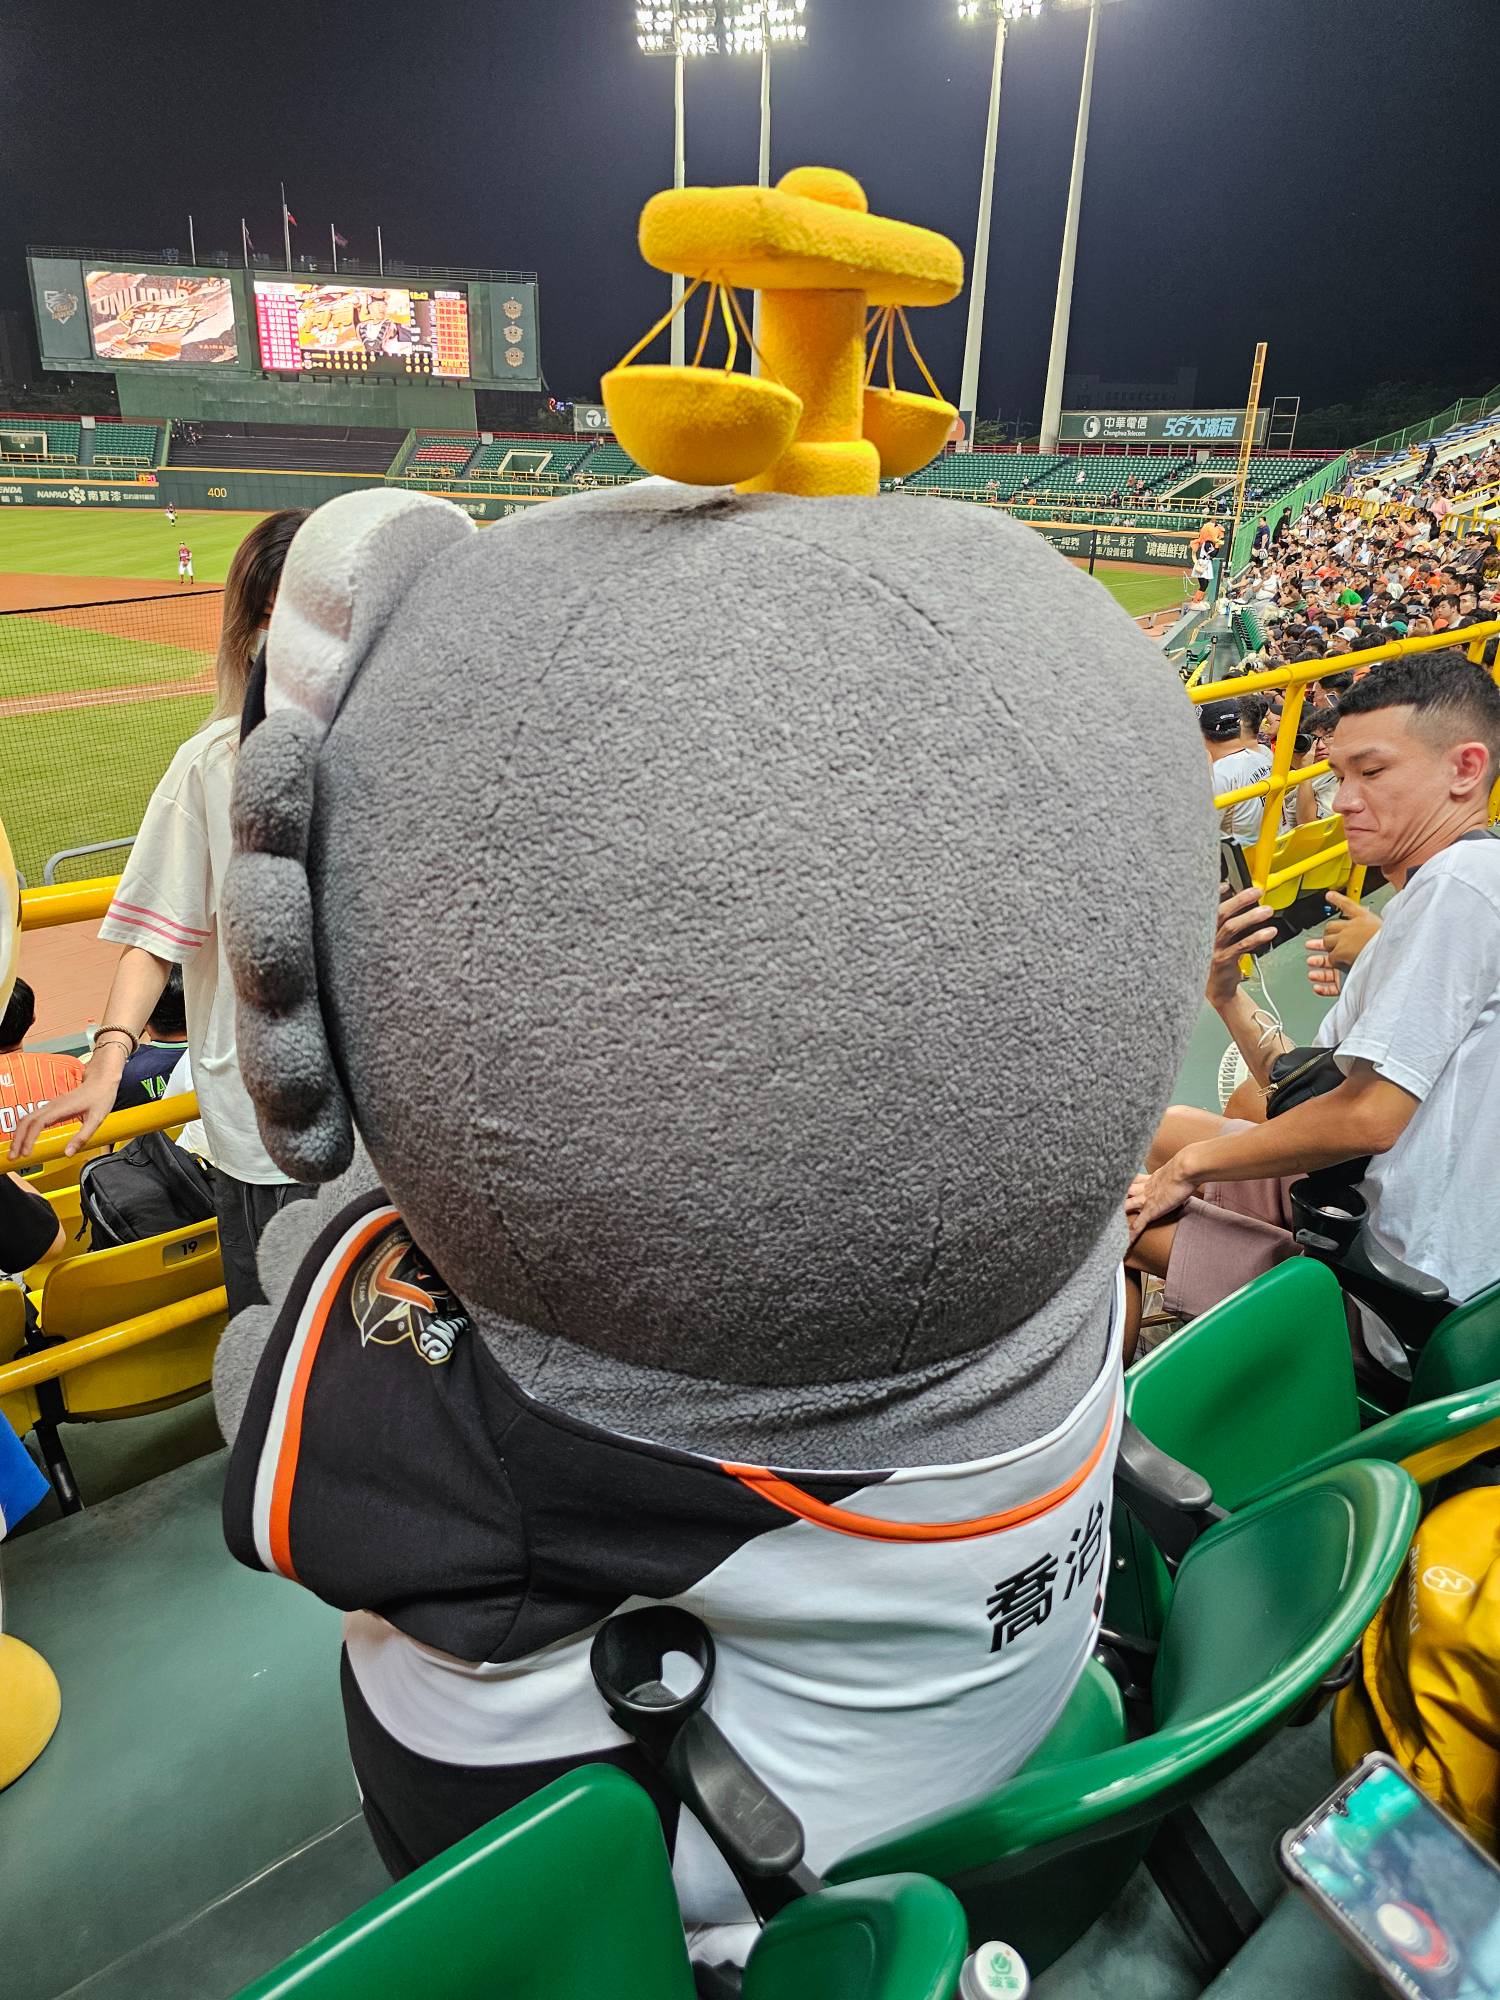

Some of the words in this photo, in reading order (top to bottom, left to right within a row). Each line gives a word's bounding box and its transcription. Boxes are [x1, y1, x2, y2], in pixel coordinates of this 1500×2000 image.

[1104, 416, 1148, 430] 中華電信
[36, 490, 69, 499] NANPAO
[207, 487, 228, 498] 400
[1146, 541, 1188, 560] 瑞穗鮮乳
[181, 1240, 198, 1256] 19
[986, 1500, 1104, 1653] 喬治
